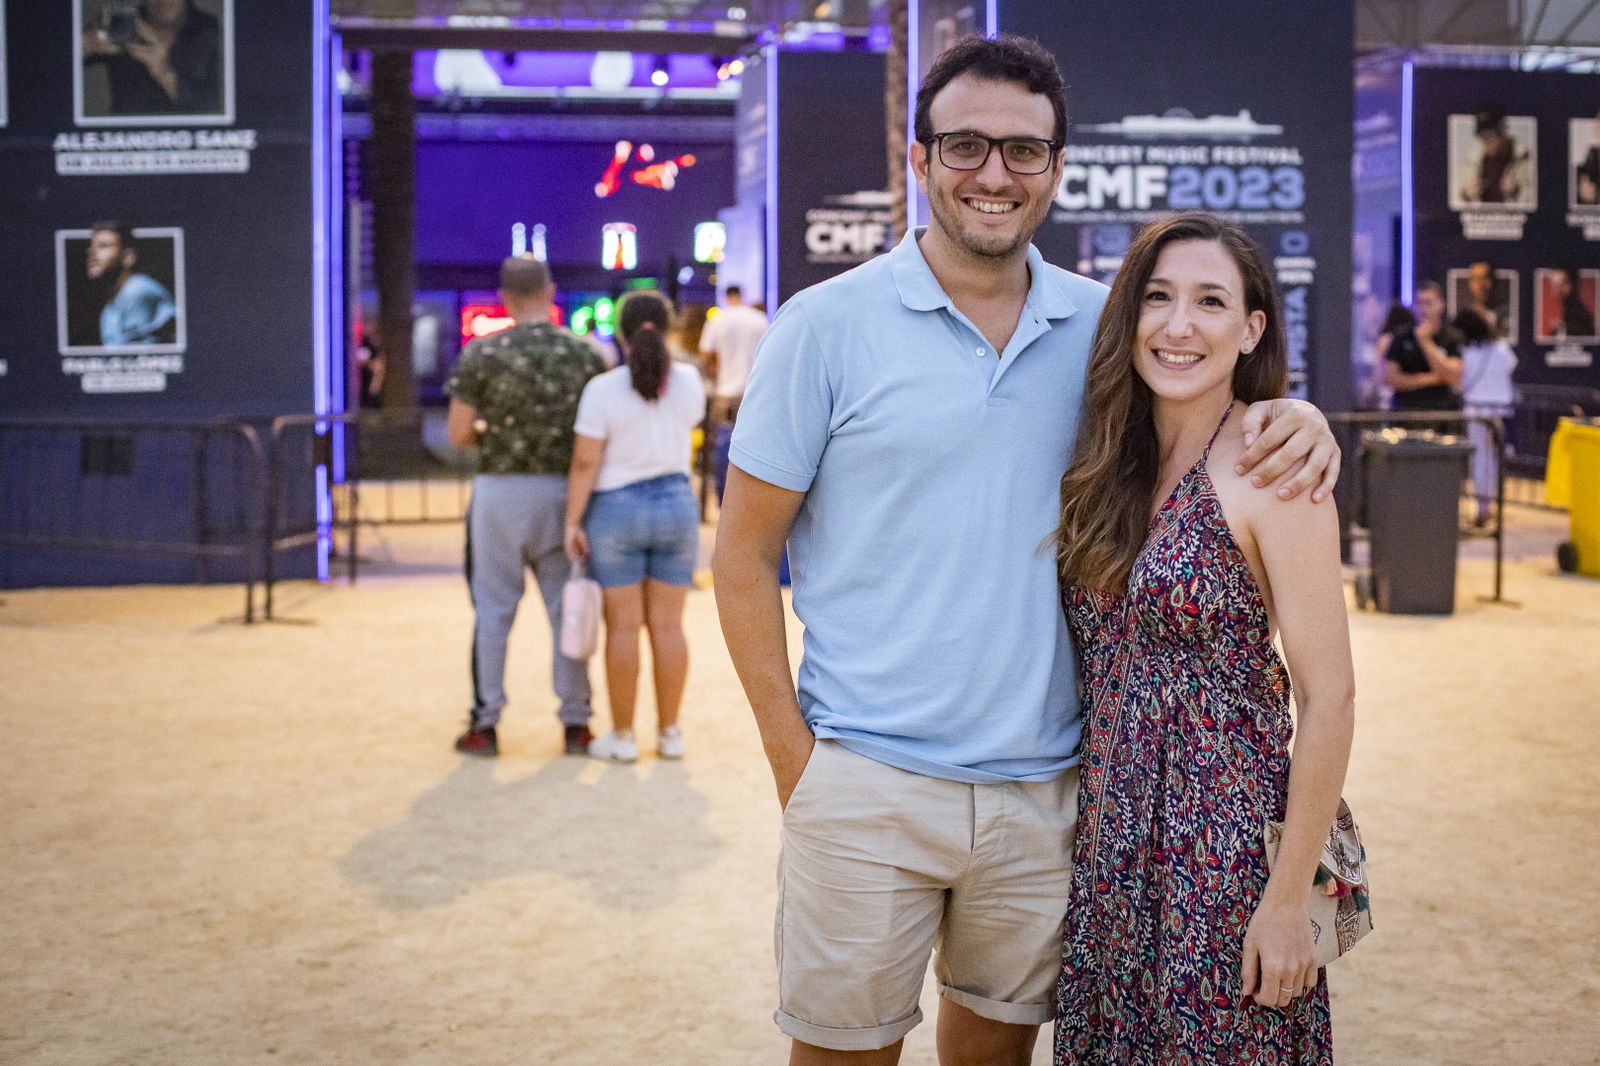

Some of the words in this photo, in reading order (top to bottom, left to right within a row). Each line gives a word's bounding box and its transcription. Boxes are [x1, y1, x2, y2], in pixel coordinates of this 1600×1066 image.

[54, 132, 193, 150] ALEJANDRO
[1064, 145, 1144, 164] ONCERT
[1147, 146, 1209, 164] MUSIC
[1211, 147, 1303, 165] FESTIVAL
